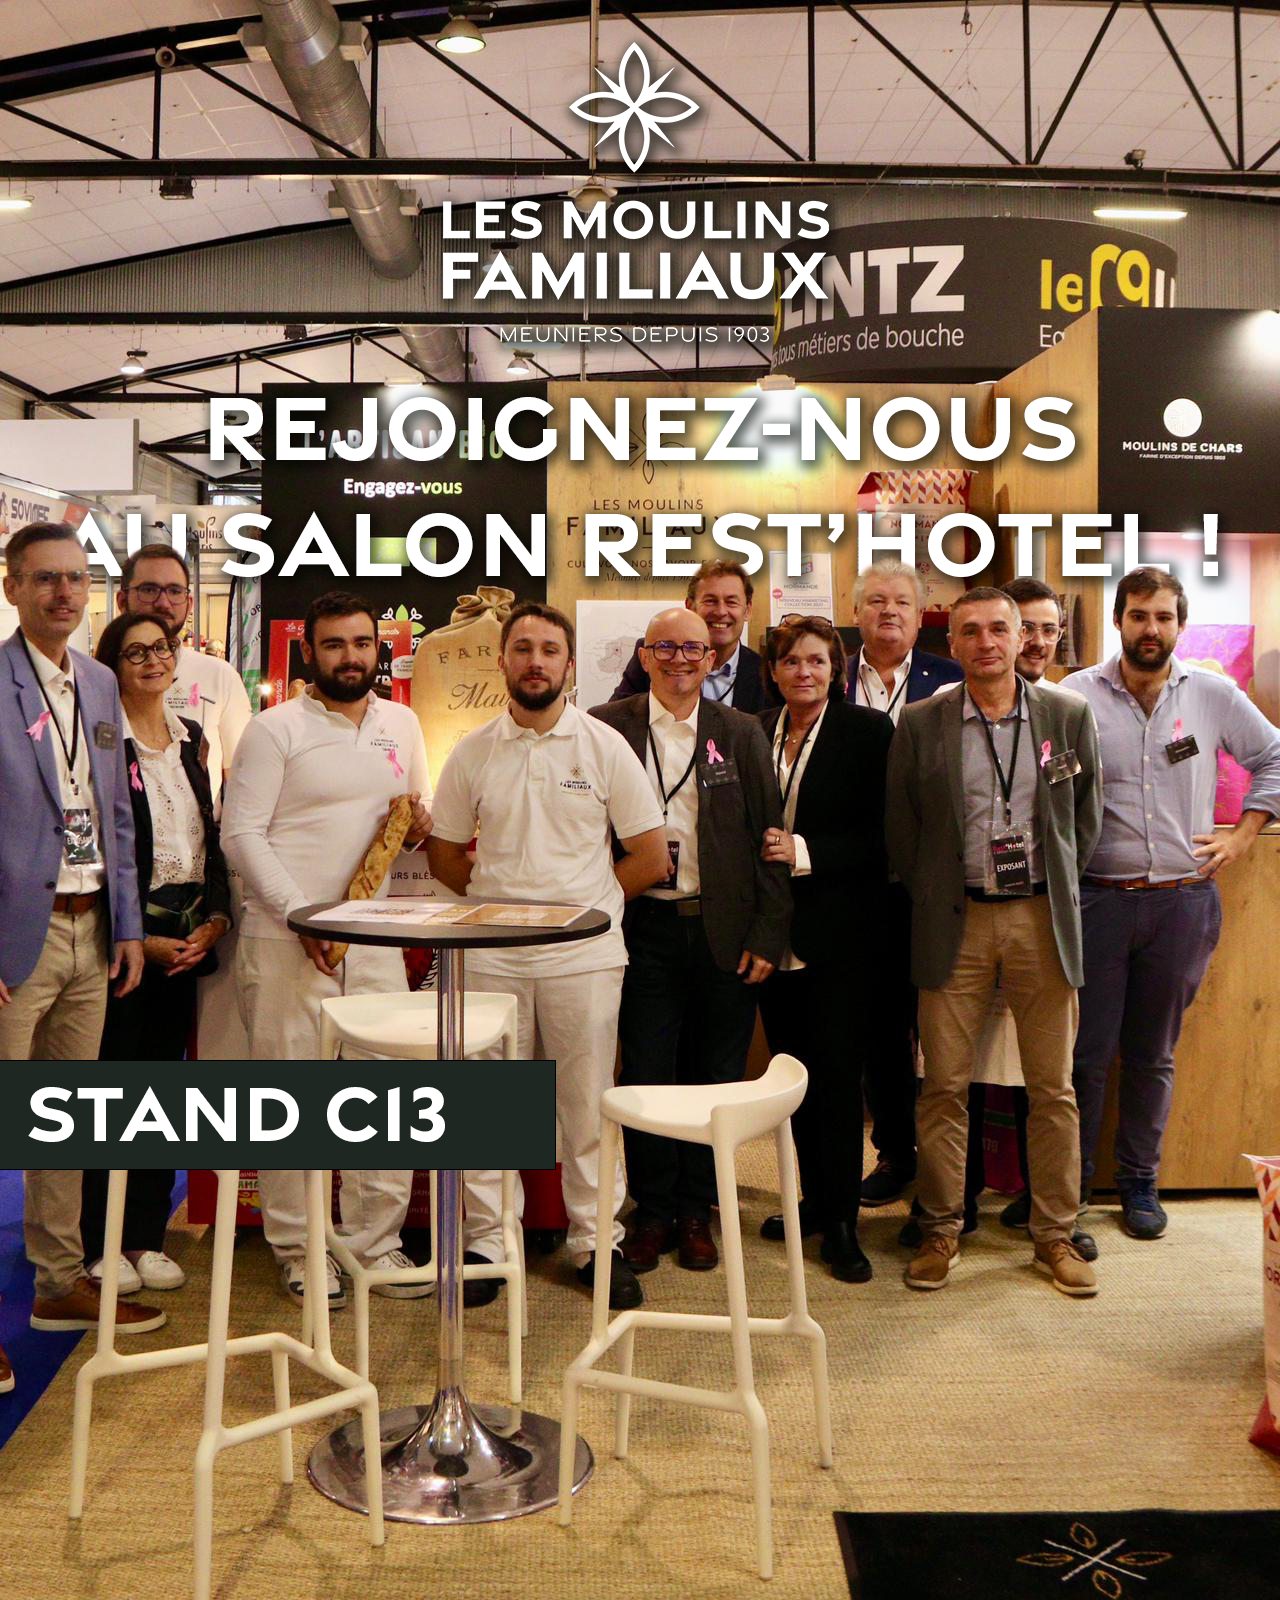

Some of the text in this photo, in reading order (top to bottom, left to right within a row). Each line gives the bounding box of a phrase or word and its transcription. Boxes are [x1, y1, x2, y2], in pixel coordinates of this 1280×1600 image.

[797, 331, 852, 359] métiers
[856, 326, 880, 351] de
[885, 322, 965, 349] bouche
[1122, 440, 1243, 453] MOULINS DE CHARS
[343, 478, 463, 498] Engagez-vous
[593, 498, 704, 511] LES MOULINS
[437, 645, 492, 665] FAR
[996, 860, 1026, 873] EXPOSANT
